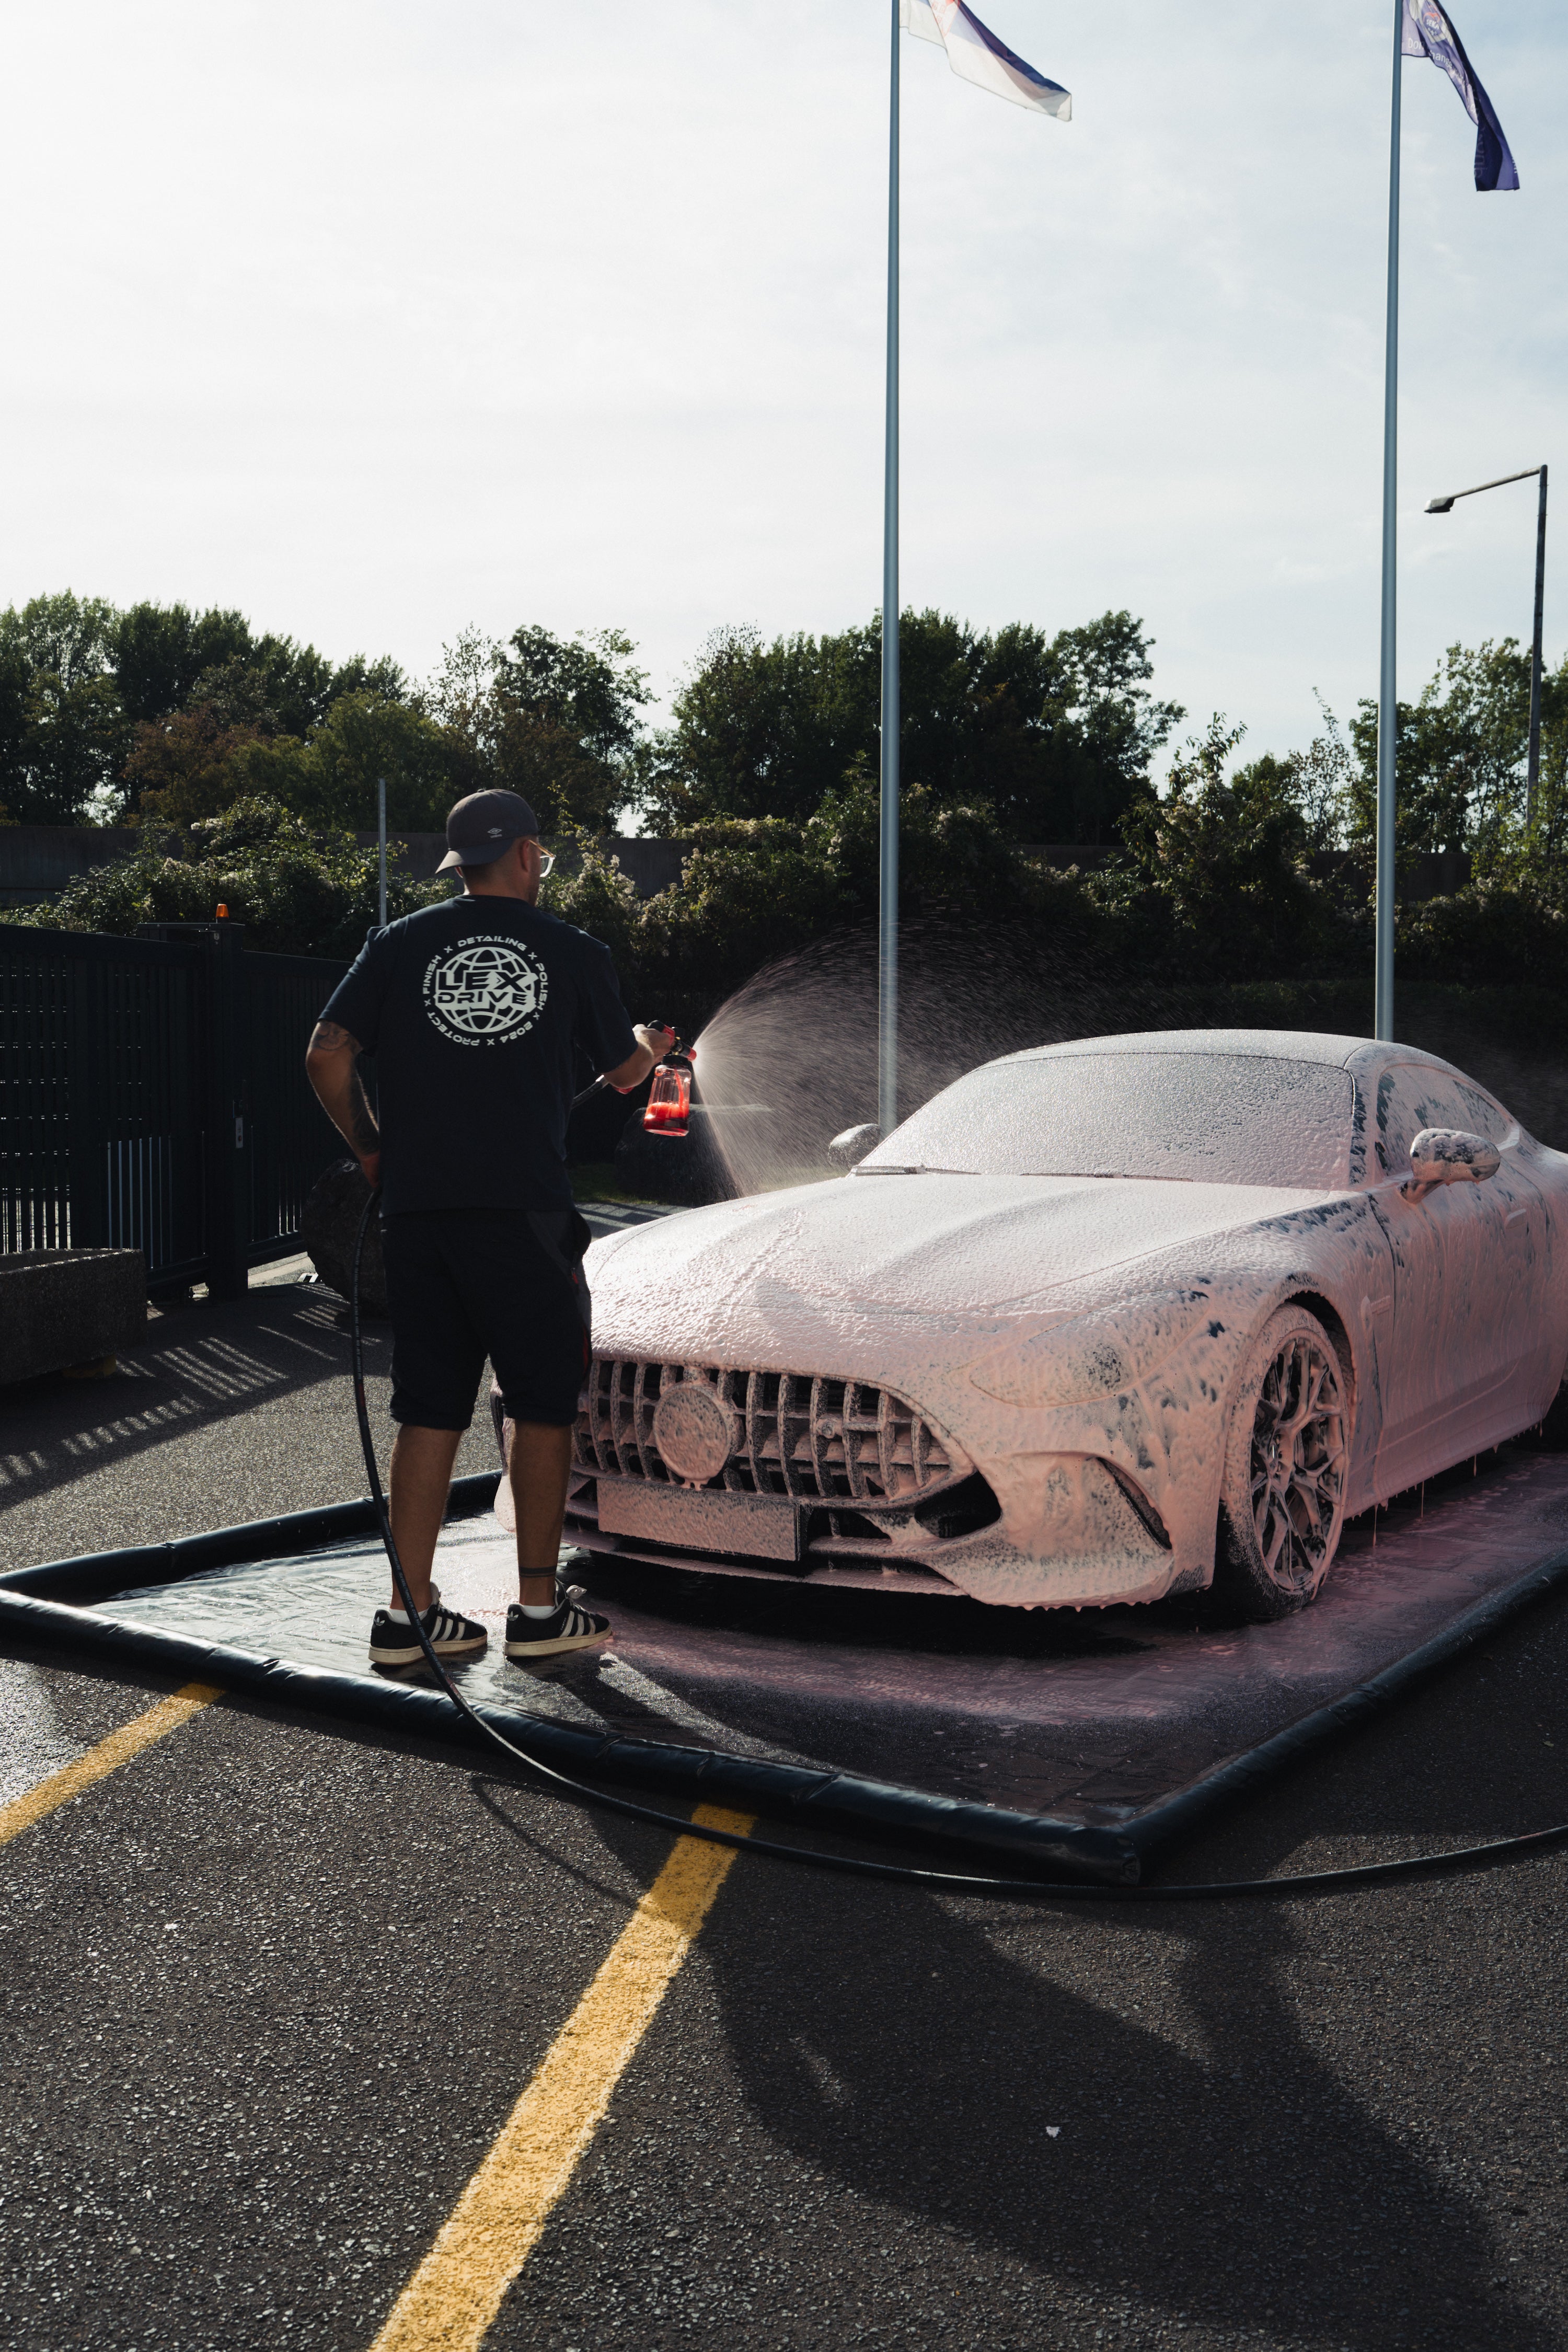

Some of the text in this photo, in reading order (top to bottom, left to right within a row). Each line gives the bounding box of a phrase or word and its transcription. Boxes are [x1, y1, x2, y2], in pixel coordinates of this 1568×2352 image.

[1430, 50, 1452, 68] hange
[457, 936, 527, 951] DETAILING
[423, 955, 442, 994] FINISH
[439, 971, 527, 992] LEX
[535, 963, 548, 1010] POLISH
[438, 991, 527, 1006] DRIVE
[428, 1012, 480, 1046] PROTECT
[500, 1021, 533, 1043] 2024
